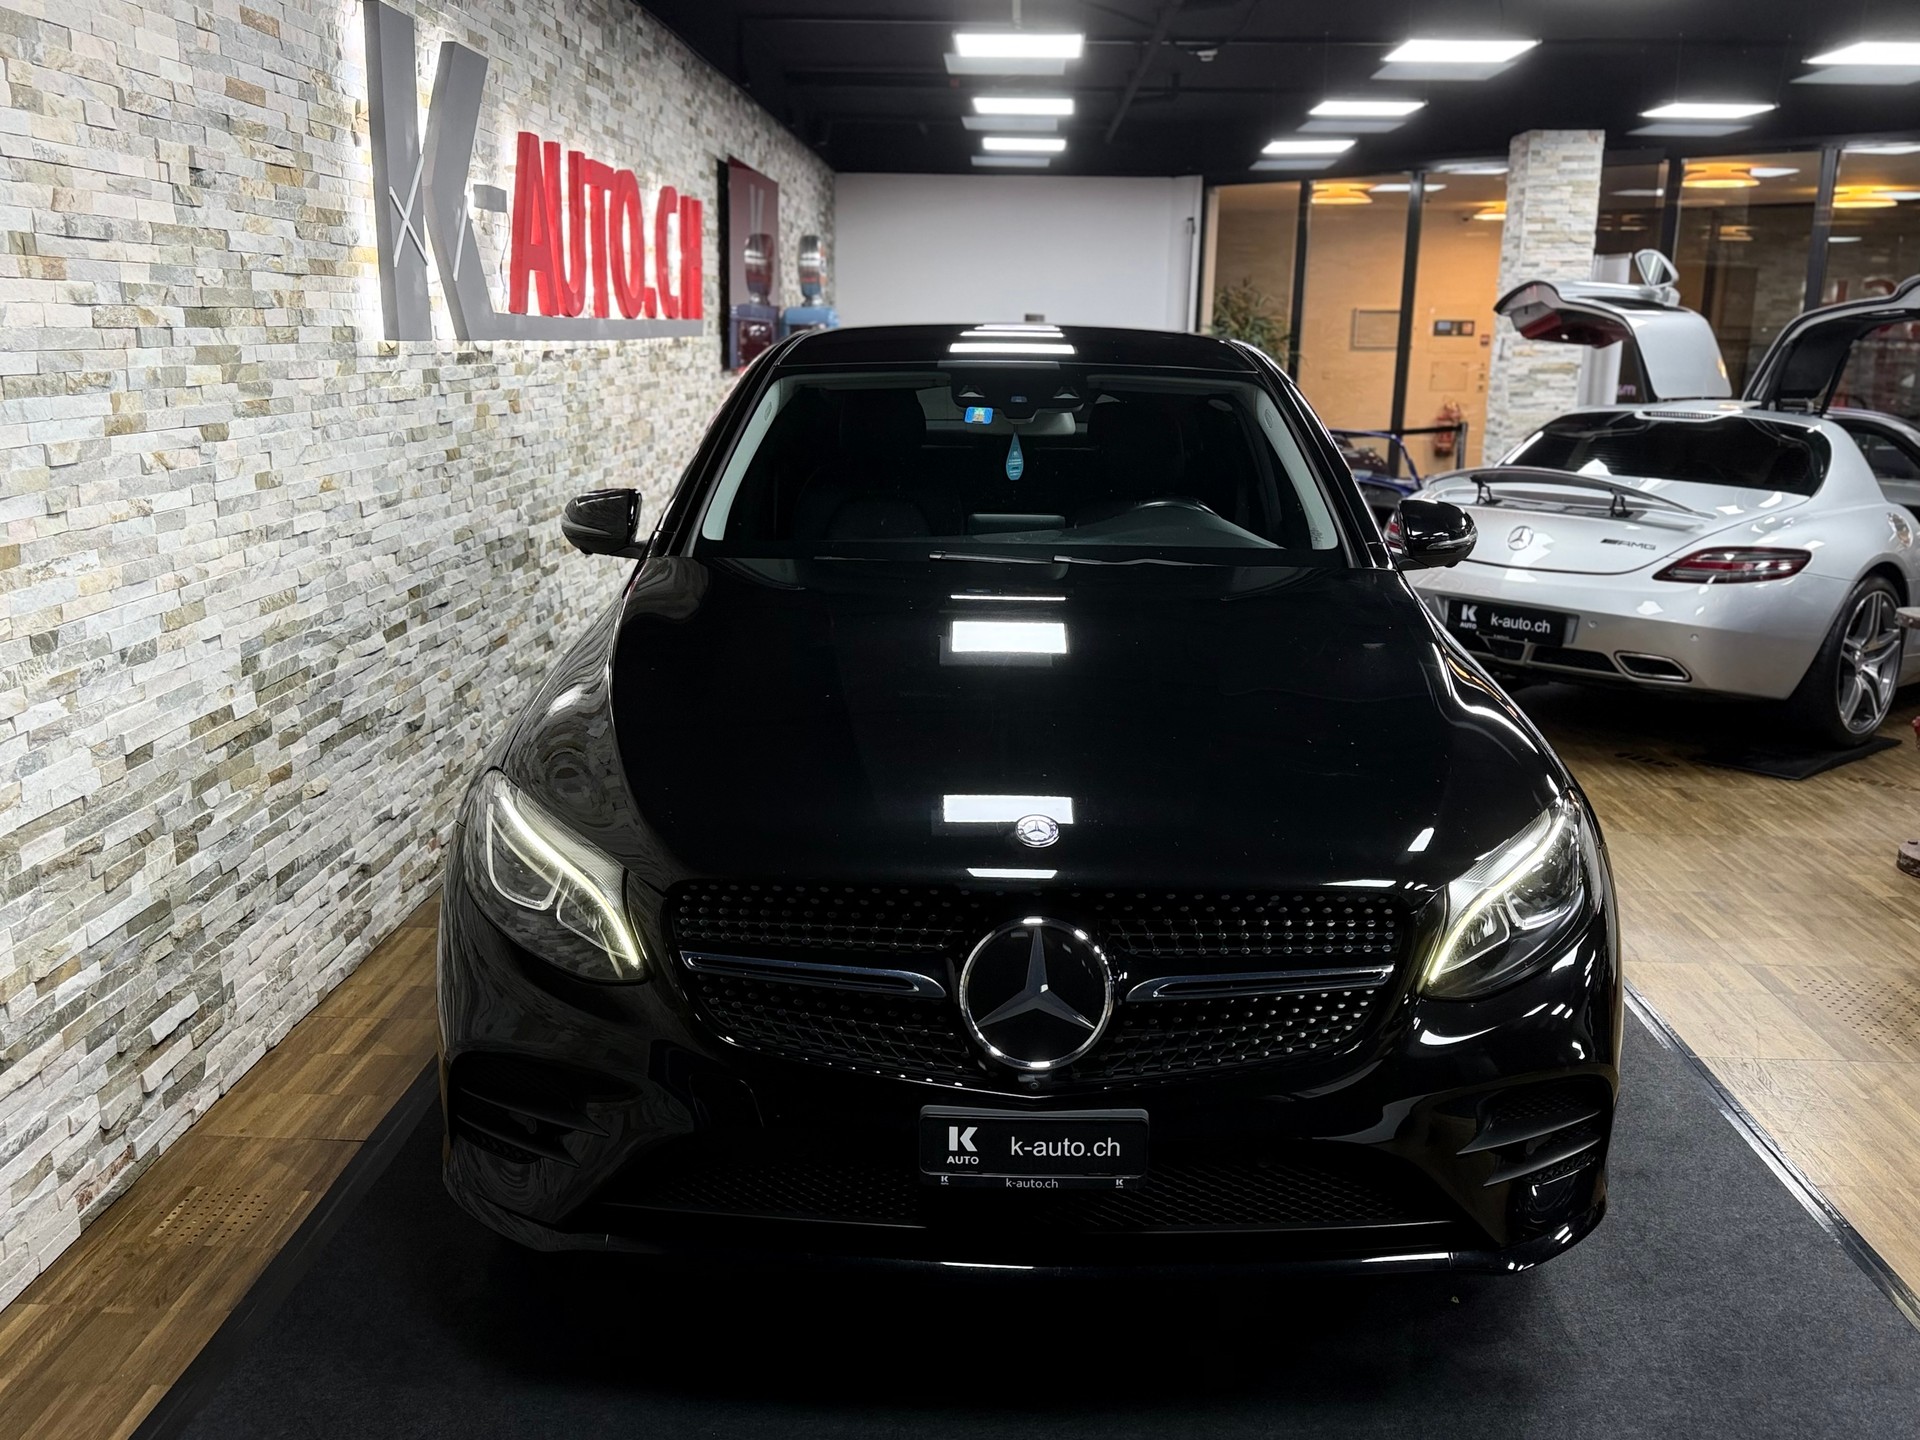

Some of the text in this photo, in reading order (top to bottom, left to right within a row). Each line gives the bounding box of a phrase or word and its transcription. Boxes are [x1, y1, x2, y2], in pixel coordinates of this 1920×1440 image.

[1616, 539, 1657, 551] AMG
[1461, 604, 1478, 622] K
[1460, 621, 1477, 630] AUTO
[1490, 612, 1551, 634] k-auto.ch
[949, 1126, 978, 1151] K
[1011, 1136, 1120, 1156] k-auto.ch
[947, 1156, 979, 1164] AUTO
[1006, 1178, 1058, 1188] k-auto.ch
